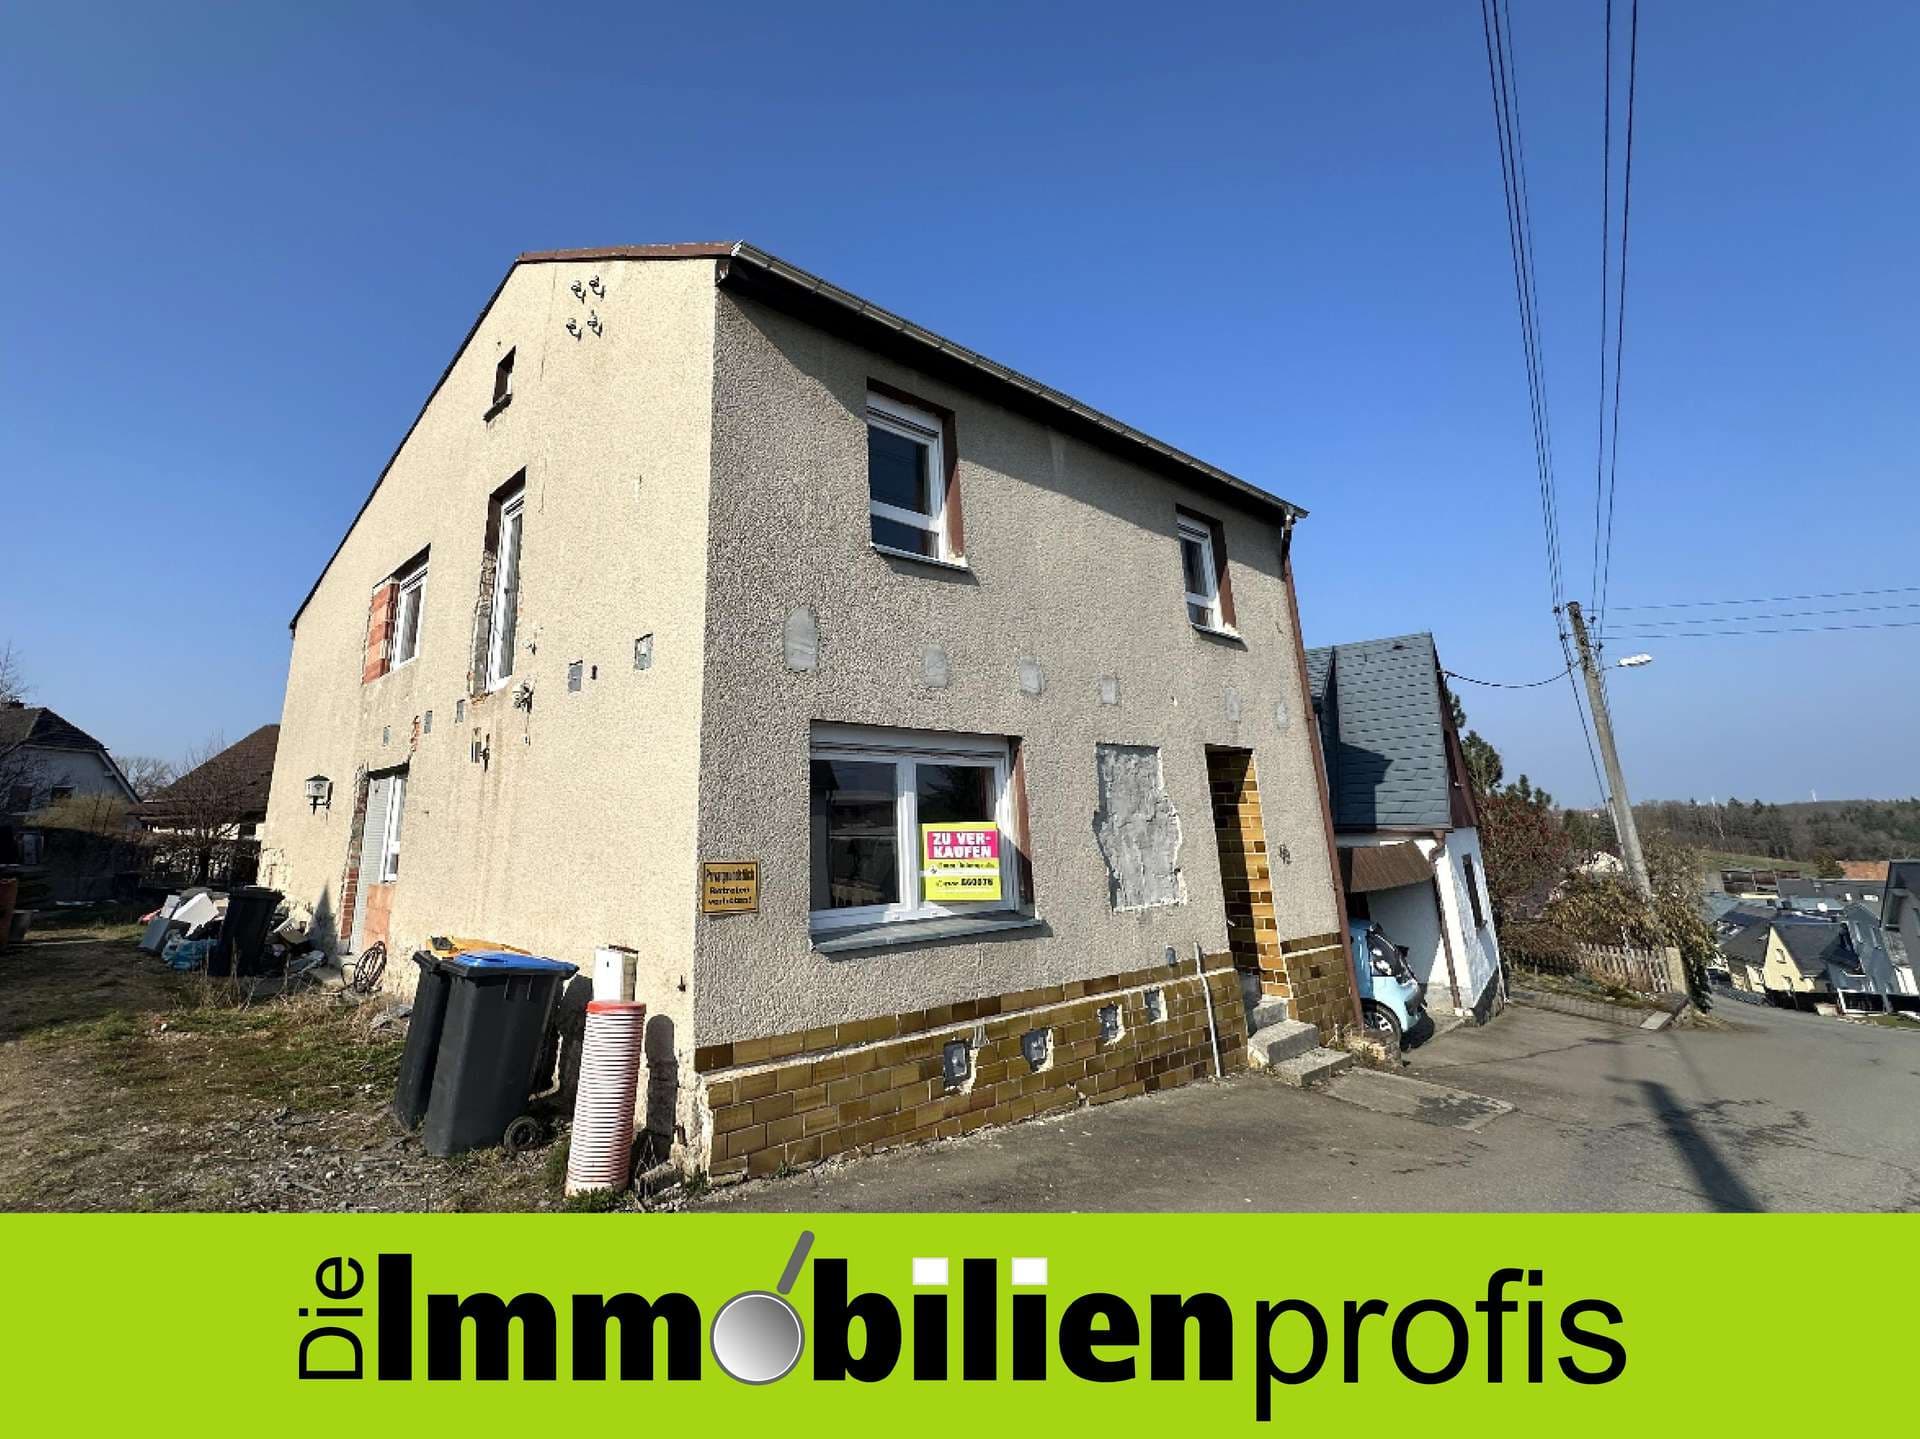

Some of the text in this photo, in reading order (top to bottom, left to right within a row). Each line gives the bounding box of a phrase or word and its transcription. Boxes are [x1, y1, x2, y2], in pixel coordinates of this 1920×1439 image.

[932, 832, 992, 846] ZU VER-
[933, 845, 992, 859] KAUFEN
